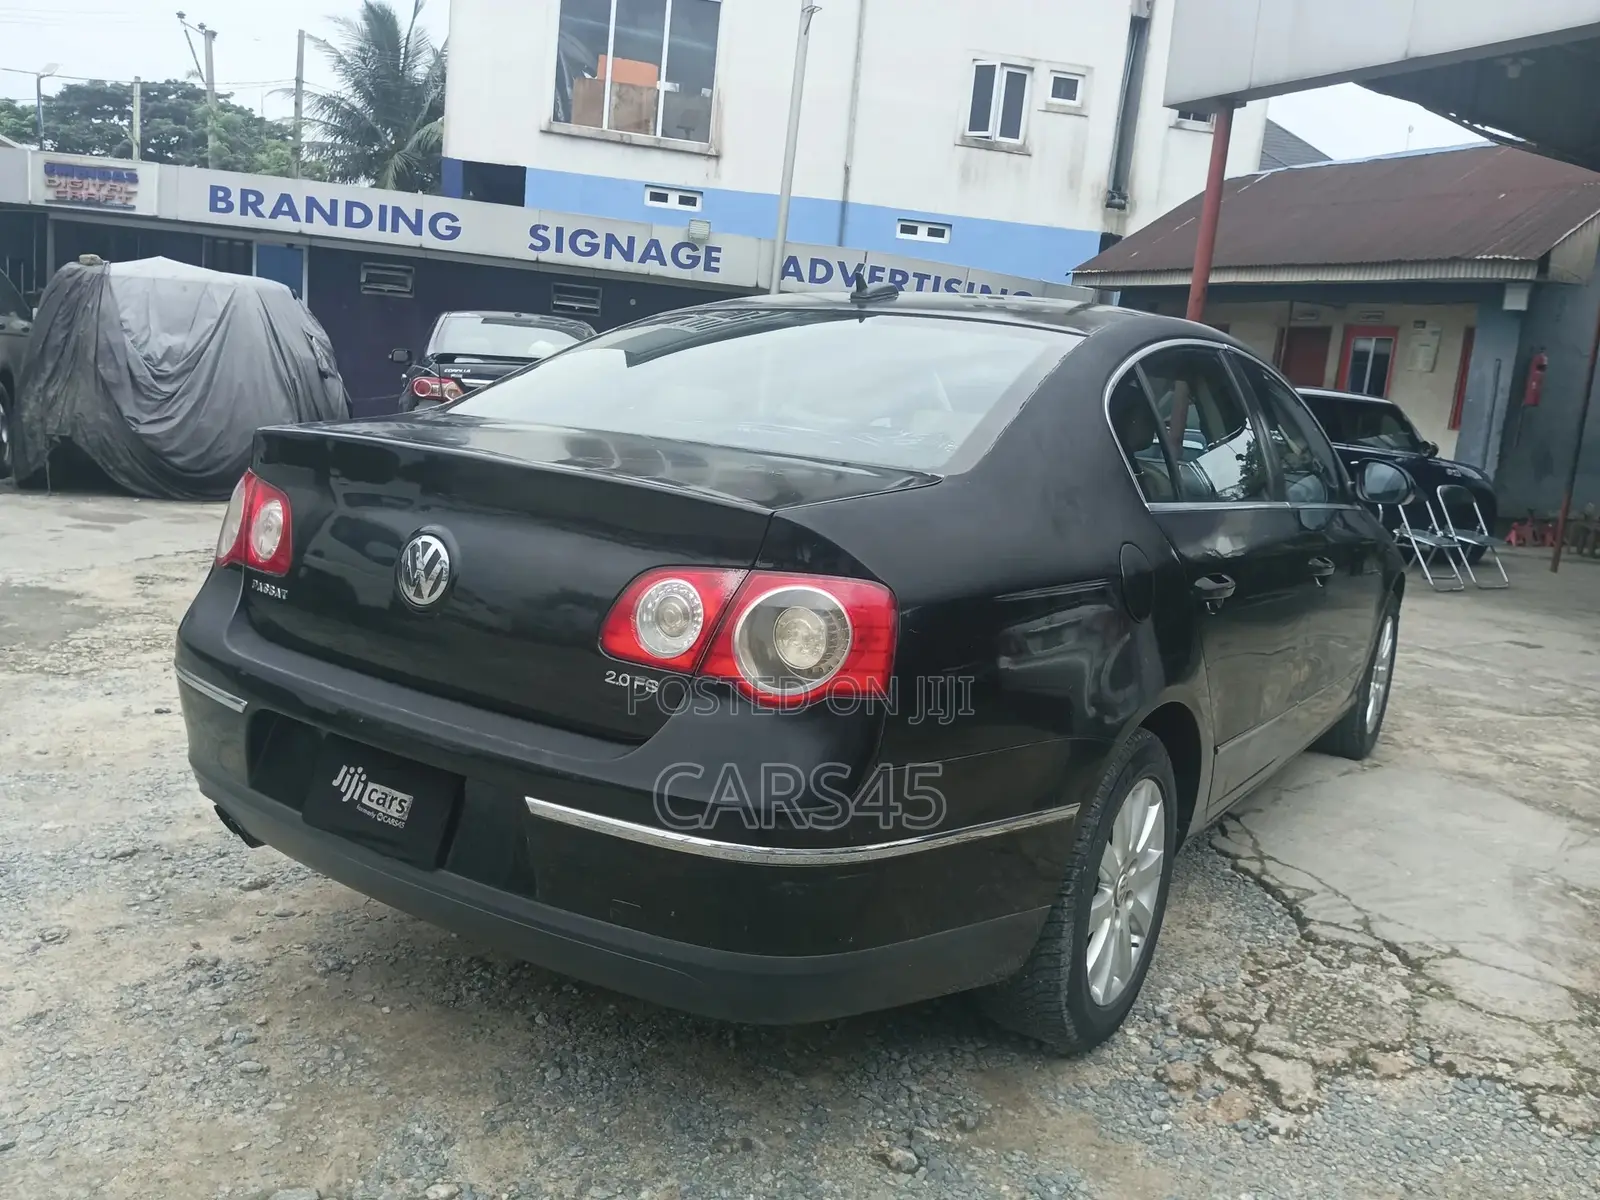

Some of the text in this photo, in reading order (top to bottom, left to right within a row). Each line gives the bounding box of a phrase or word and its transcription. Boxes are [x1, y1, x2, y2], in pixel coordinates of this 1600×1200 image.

[209, 185, 462, 241] BRANDING
[528, 223, 722, 273] SIGNAGE
[781, 255, 1034, 296] ADVERTIS
[251, 579, 288, 600] PASSAT
